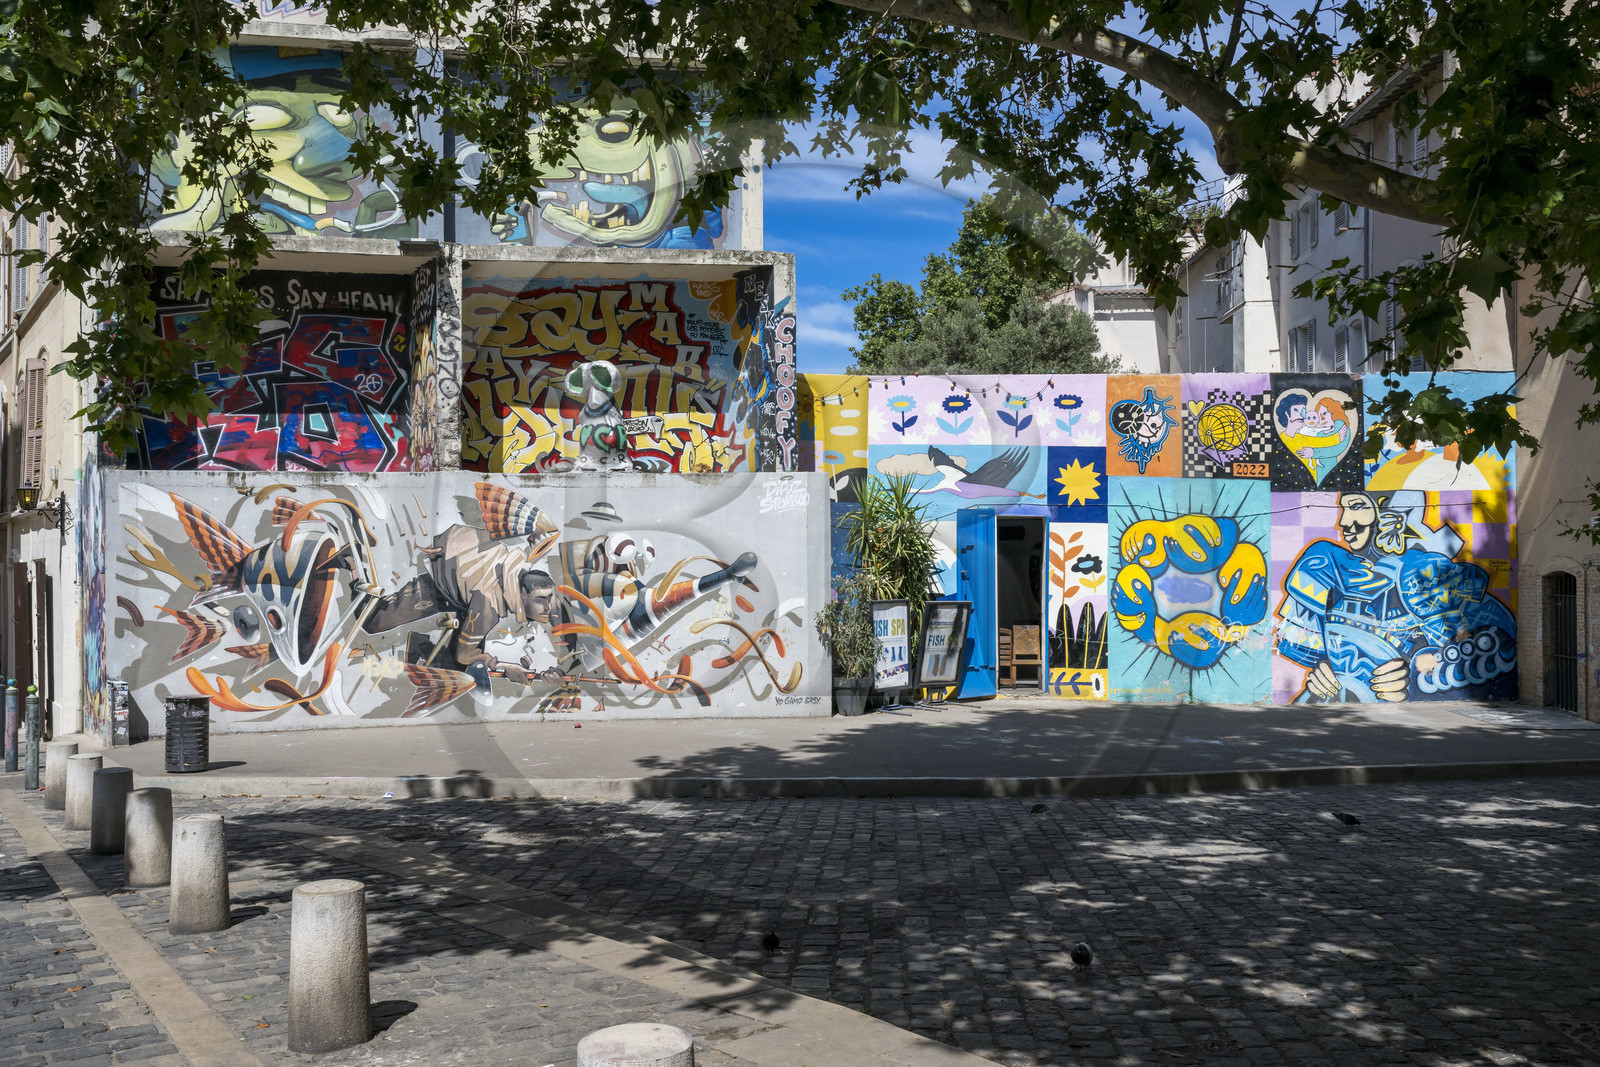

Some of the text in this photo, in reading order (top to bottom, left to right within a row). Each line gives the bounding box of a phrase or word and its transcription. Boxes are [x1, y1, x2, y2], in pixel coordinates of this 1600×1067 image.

[286, 279, 328, 310] SAY
[775, 317, 797, 471] CHOOFY
[1236, 464, 1266, 476] 2022
[873, 619, 906, 637] FISH SPA
[927, 634, 946, 646] FISH
